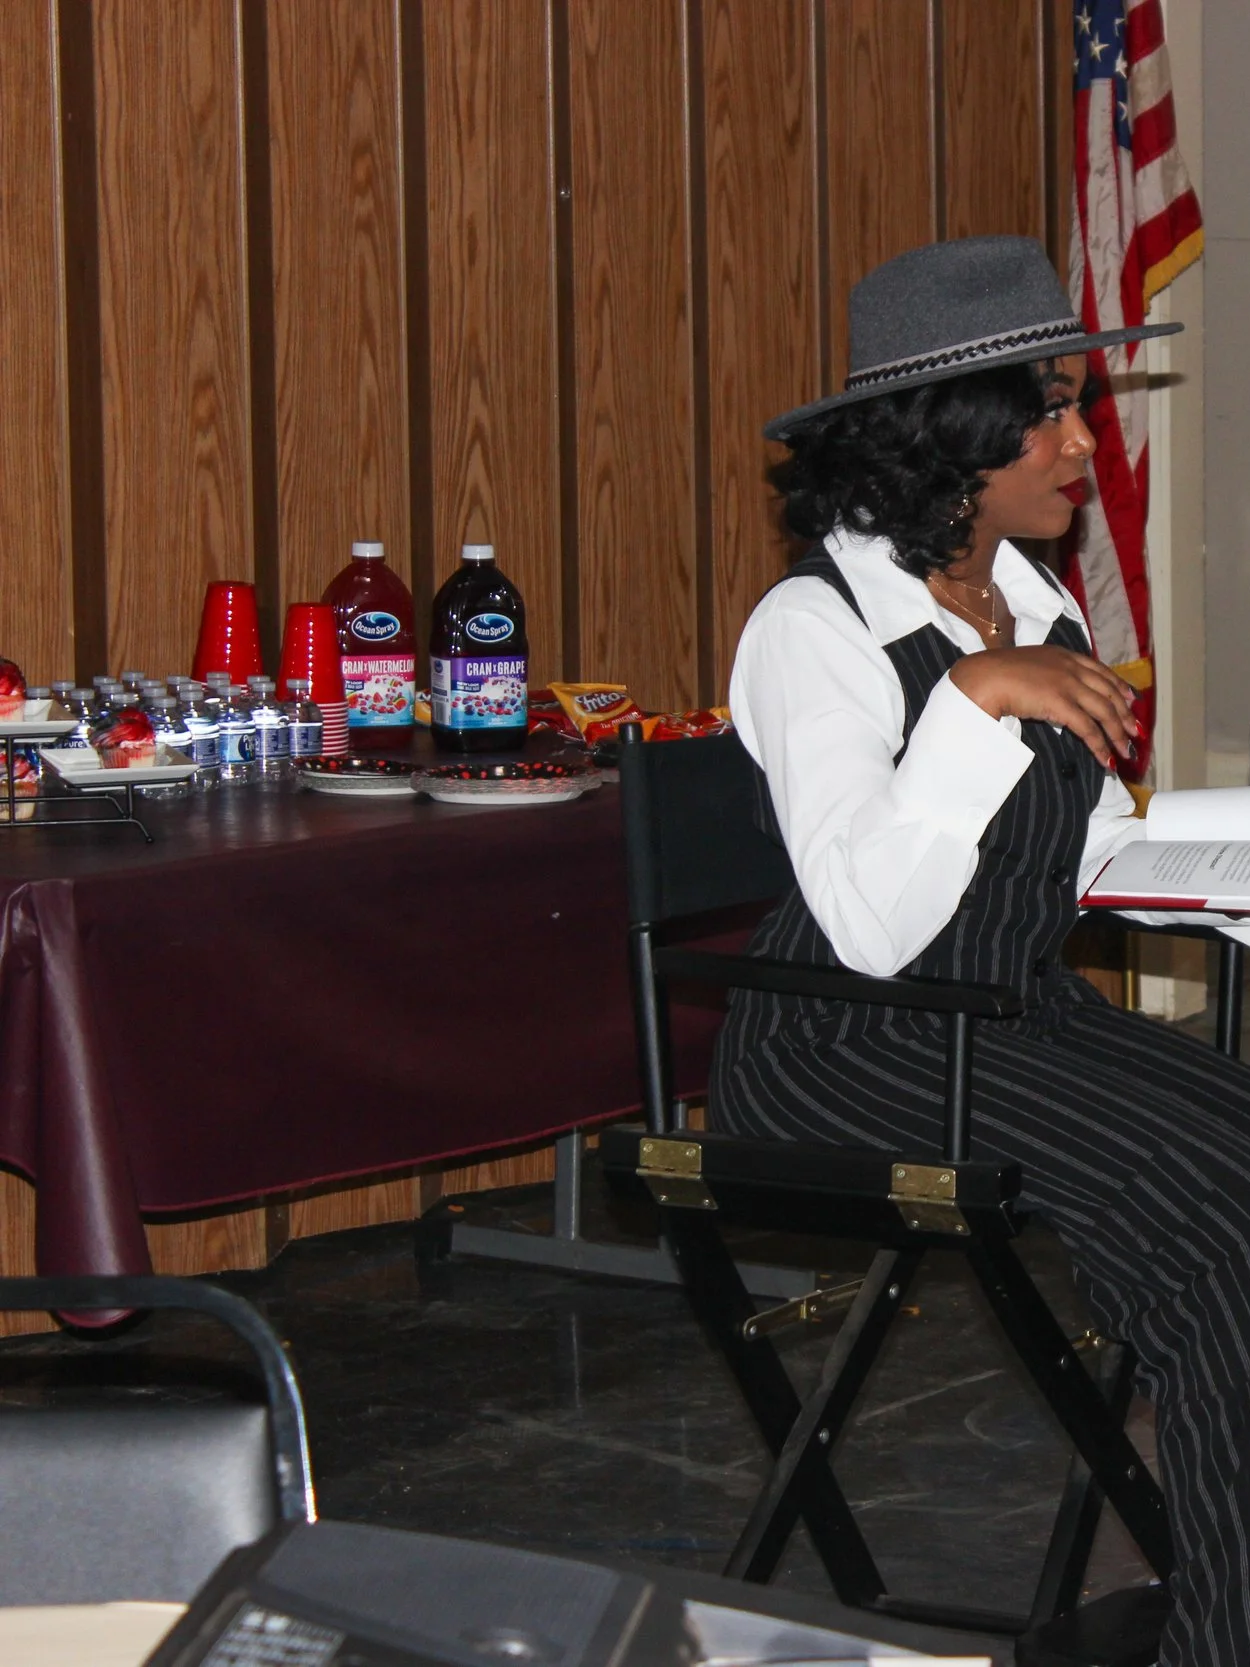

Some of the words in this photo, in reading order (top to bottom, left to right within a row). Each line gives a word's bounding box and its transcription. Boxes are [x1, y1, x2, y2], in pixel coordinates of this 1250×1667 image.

[355, 620, 376, 635] Ocean
[375, 622, 395, 636] Spray
[470, 622, 490, 636] Ocean
[490, 623, 509, 637] Spray
